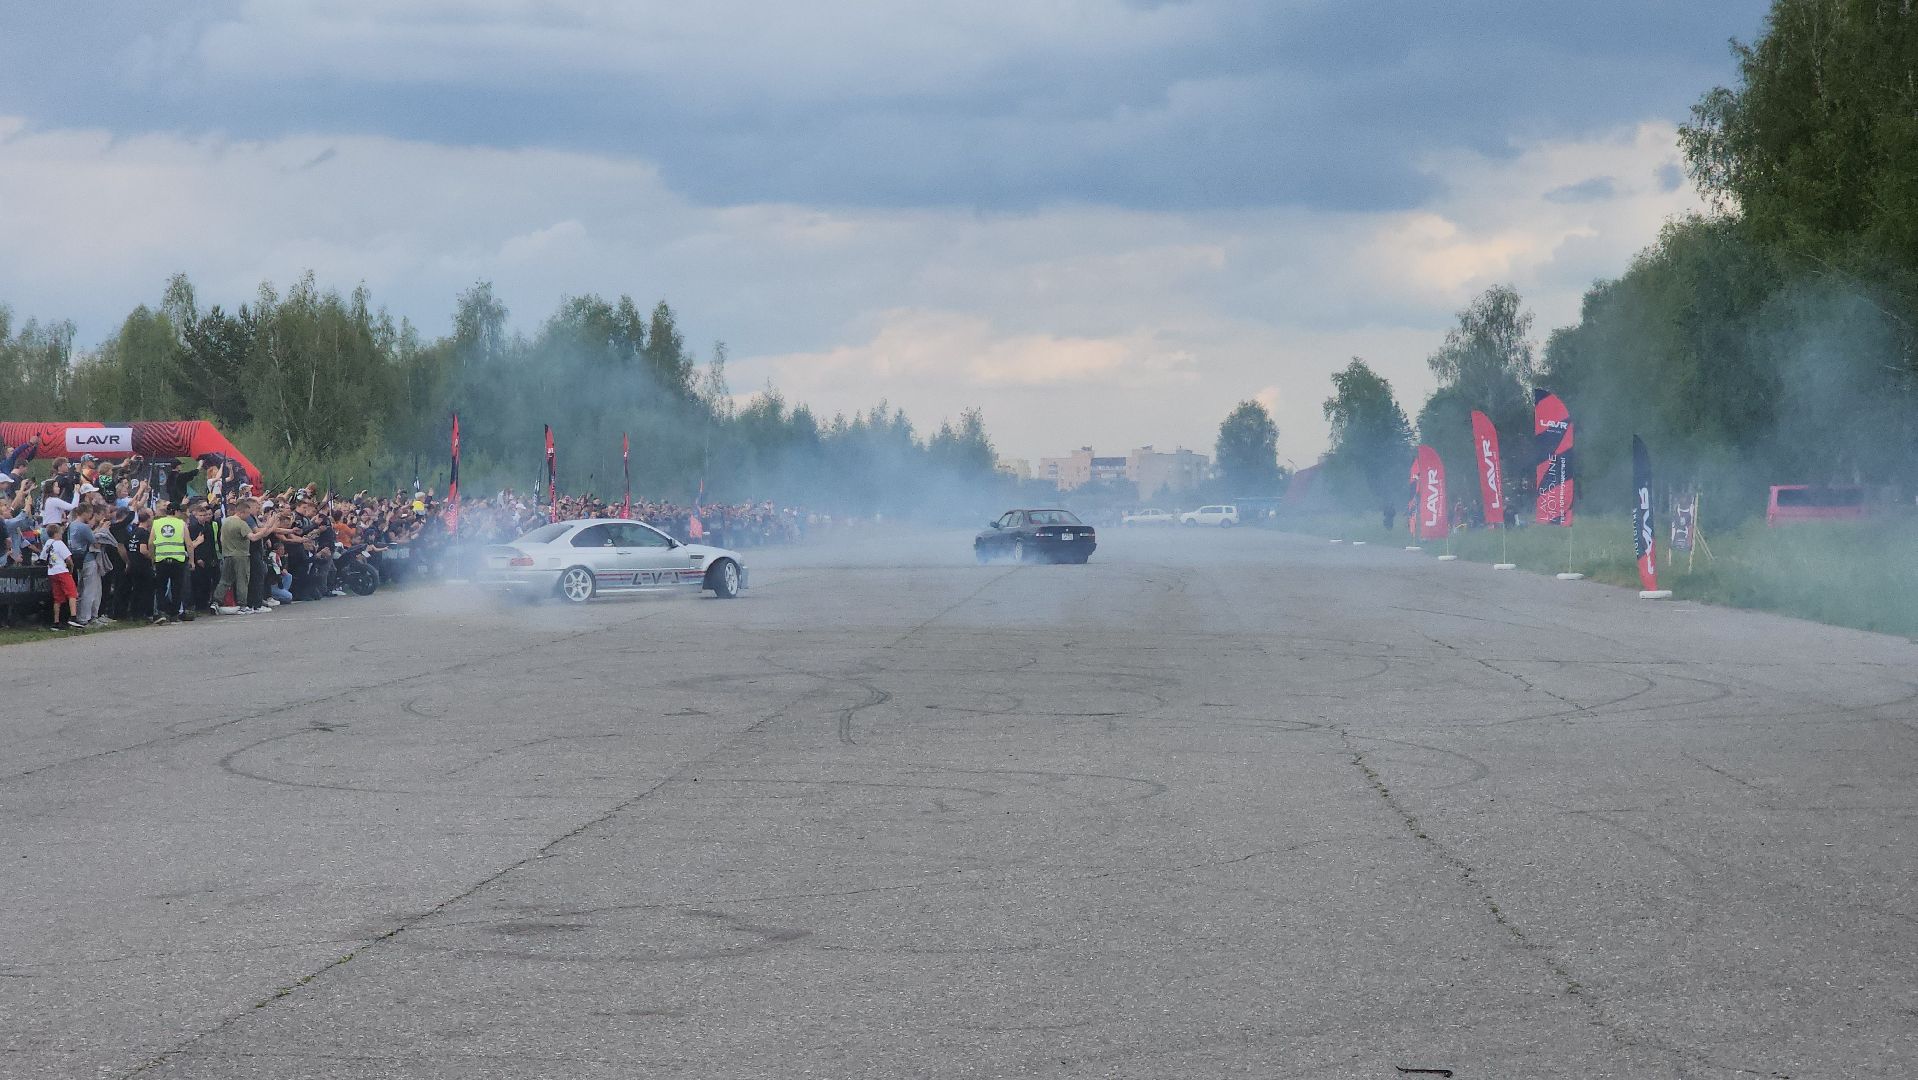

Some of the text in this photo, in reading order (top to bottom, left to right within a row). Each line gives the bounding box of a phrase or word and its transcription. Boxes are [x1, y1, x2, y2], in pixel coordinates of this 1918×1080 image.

[76, 435, 120, 445] LAVR
[1540, 420, 1568, 430] LAVR
[1483, 440, 1500, 509] LAVR
[1547, 453, 1557, 521] MOTOLINE
[1426, 469, 1439, 527] LAVR
[1540, 487, 1549, 521] LAVR
